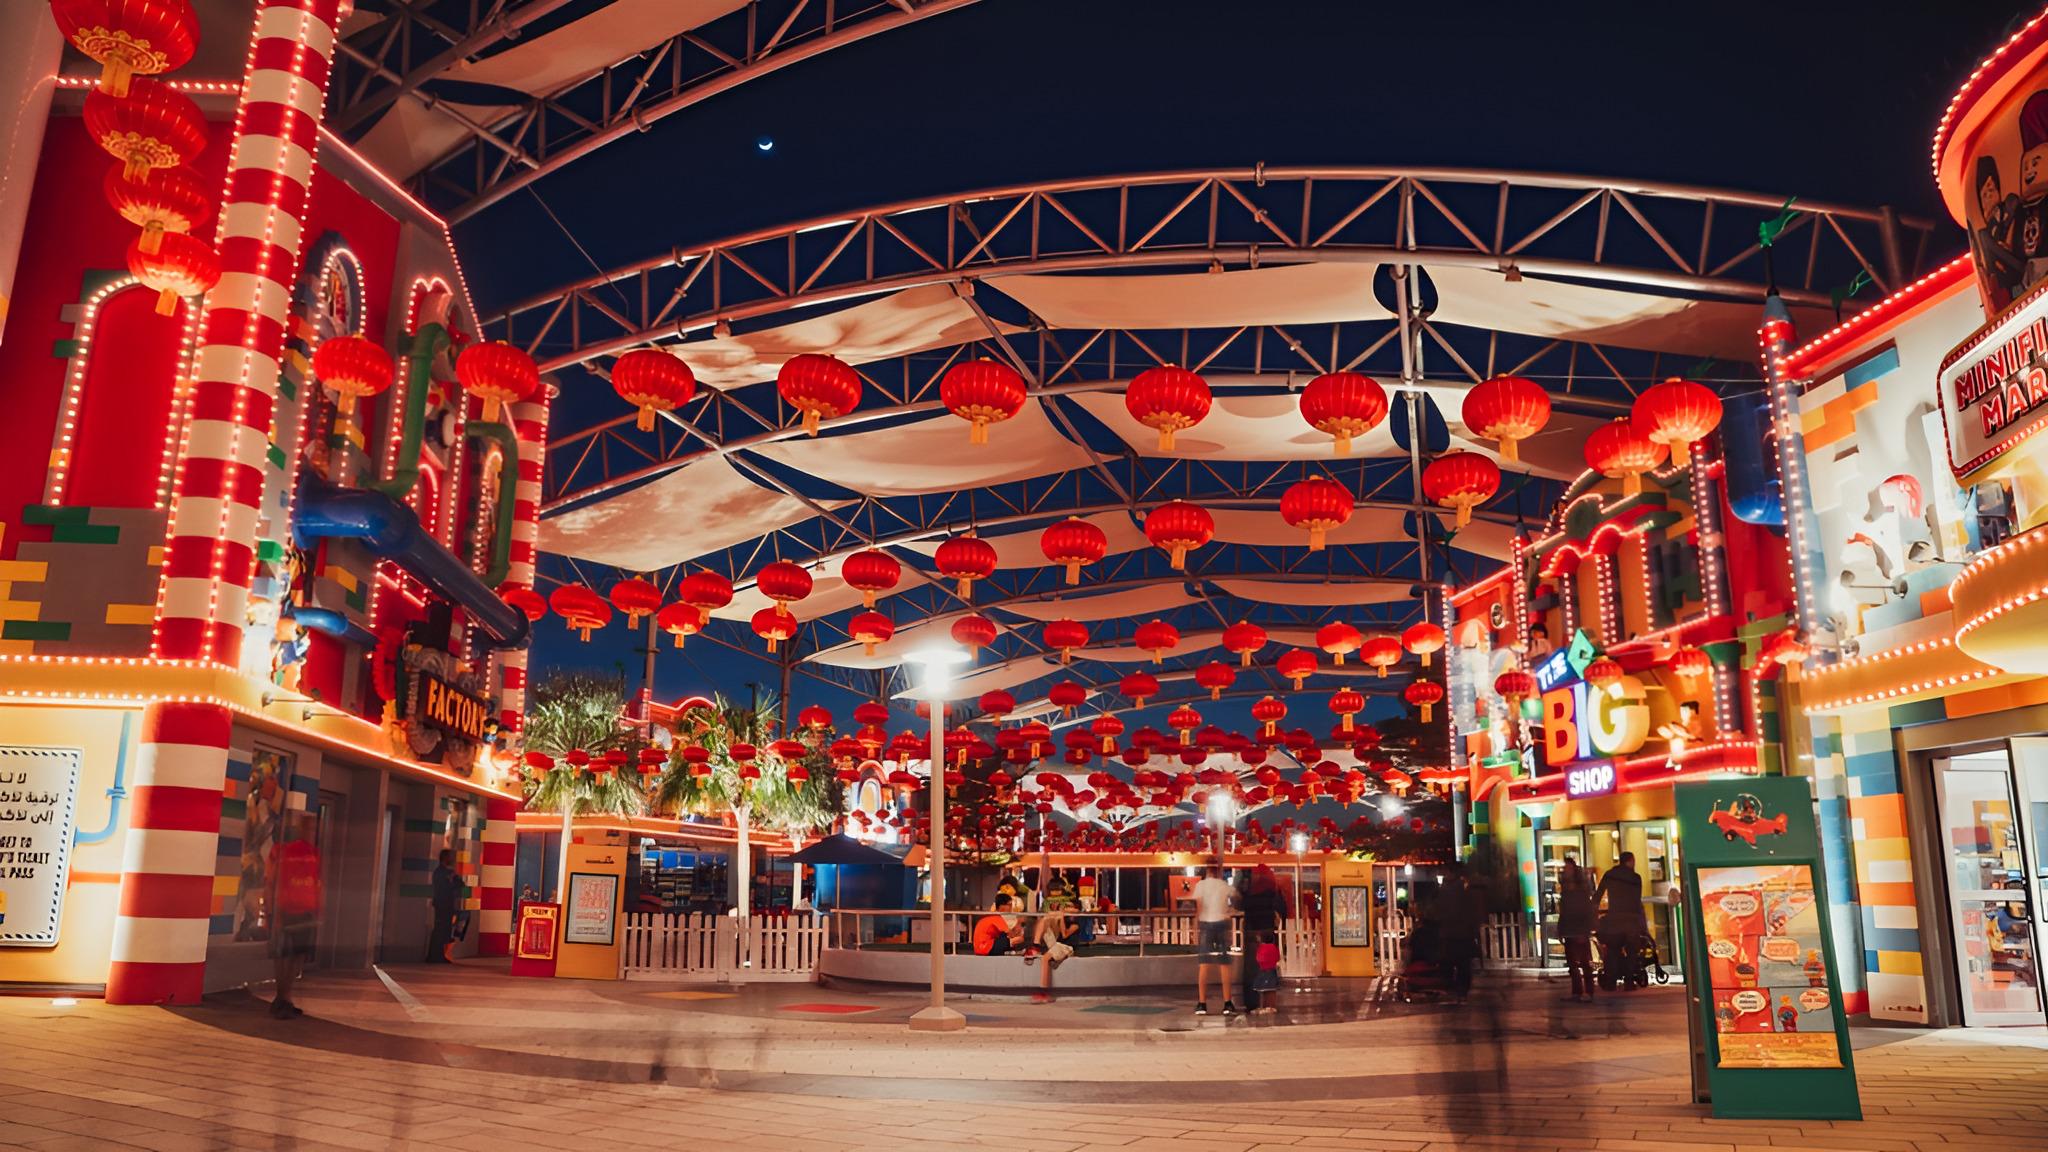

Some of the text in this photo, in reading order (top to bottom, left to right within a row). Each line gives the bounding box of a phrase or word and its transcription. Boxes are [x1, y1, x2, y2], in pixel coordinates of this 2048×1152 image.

[428, 677, 487, 739] FACTORY
[1543, 680, 1641, 765] BIG
[1568, 765, 1614, 795] SHOP
